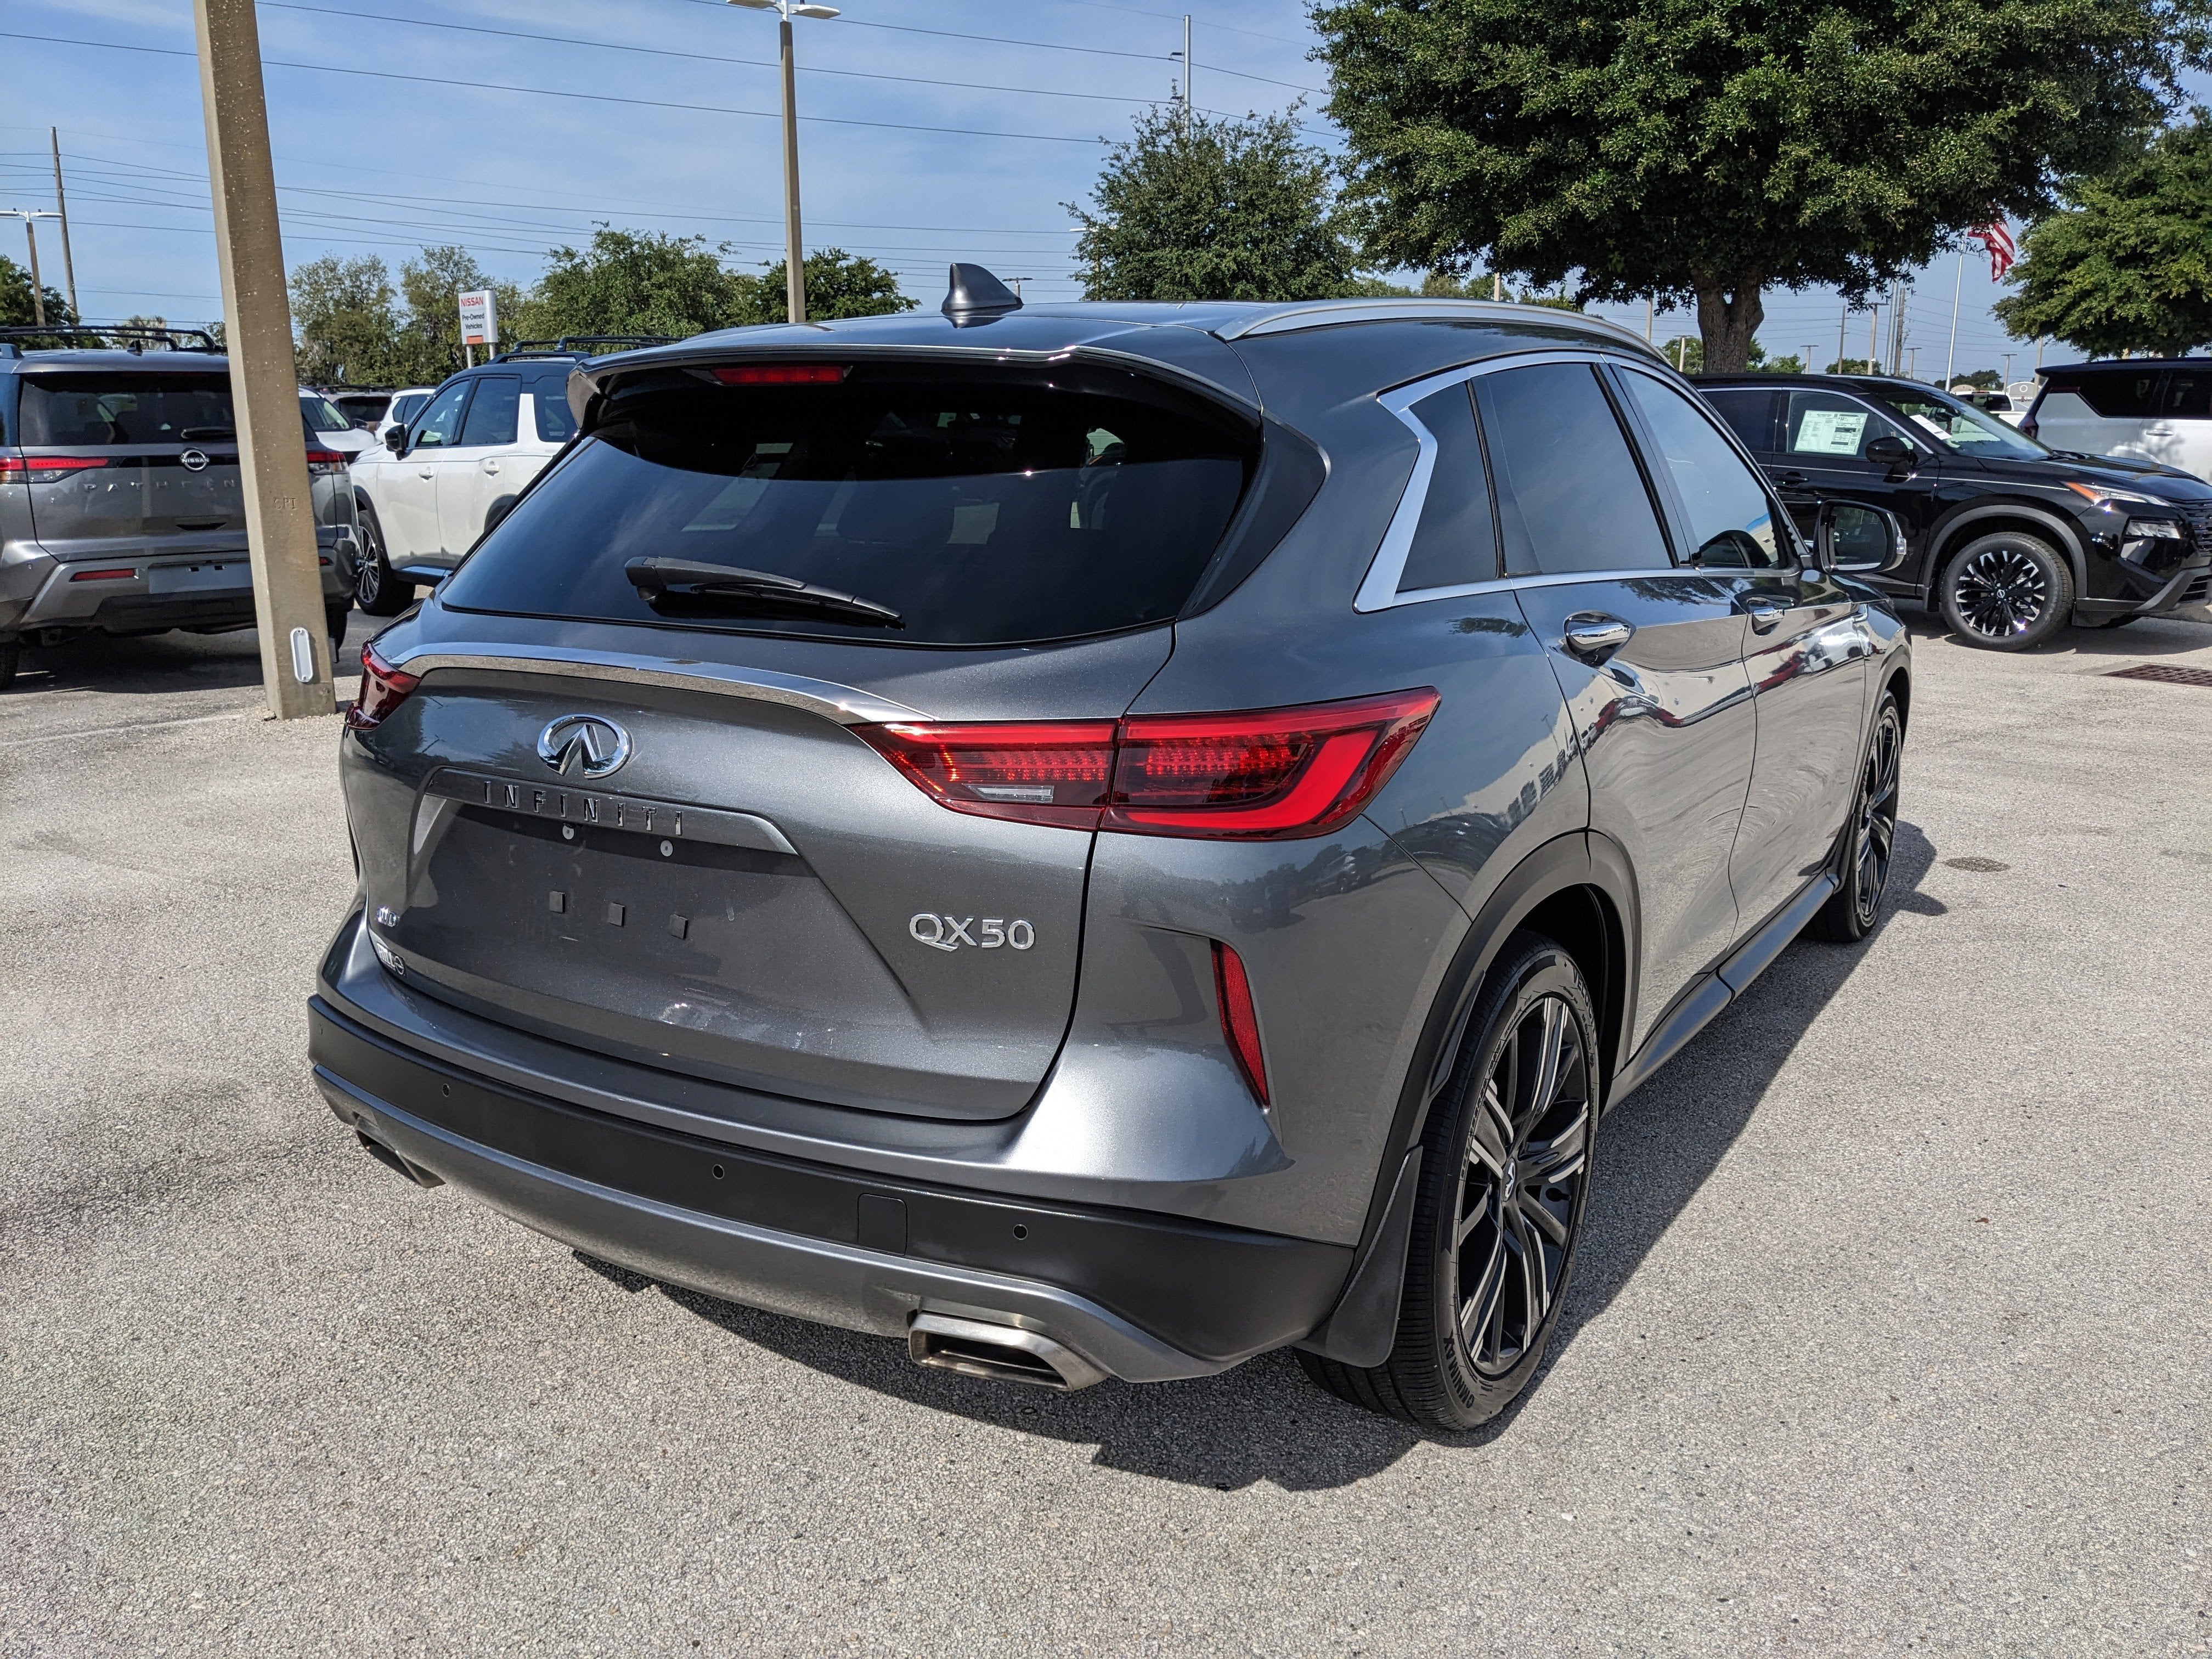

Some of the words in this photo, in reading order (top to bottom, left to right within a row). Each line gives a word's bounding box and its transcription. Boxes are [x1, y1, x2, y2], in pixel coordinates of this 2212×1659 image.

[461, 296, 483, 307] NISSAN
[484, 781, 682, 836] INFINITI
[909, 913, 1035, 952] QX50
[1443, 1329, 1475, 1408] OMNIMAX
